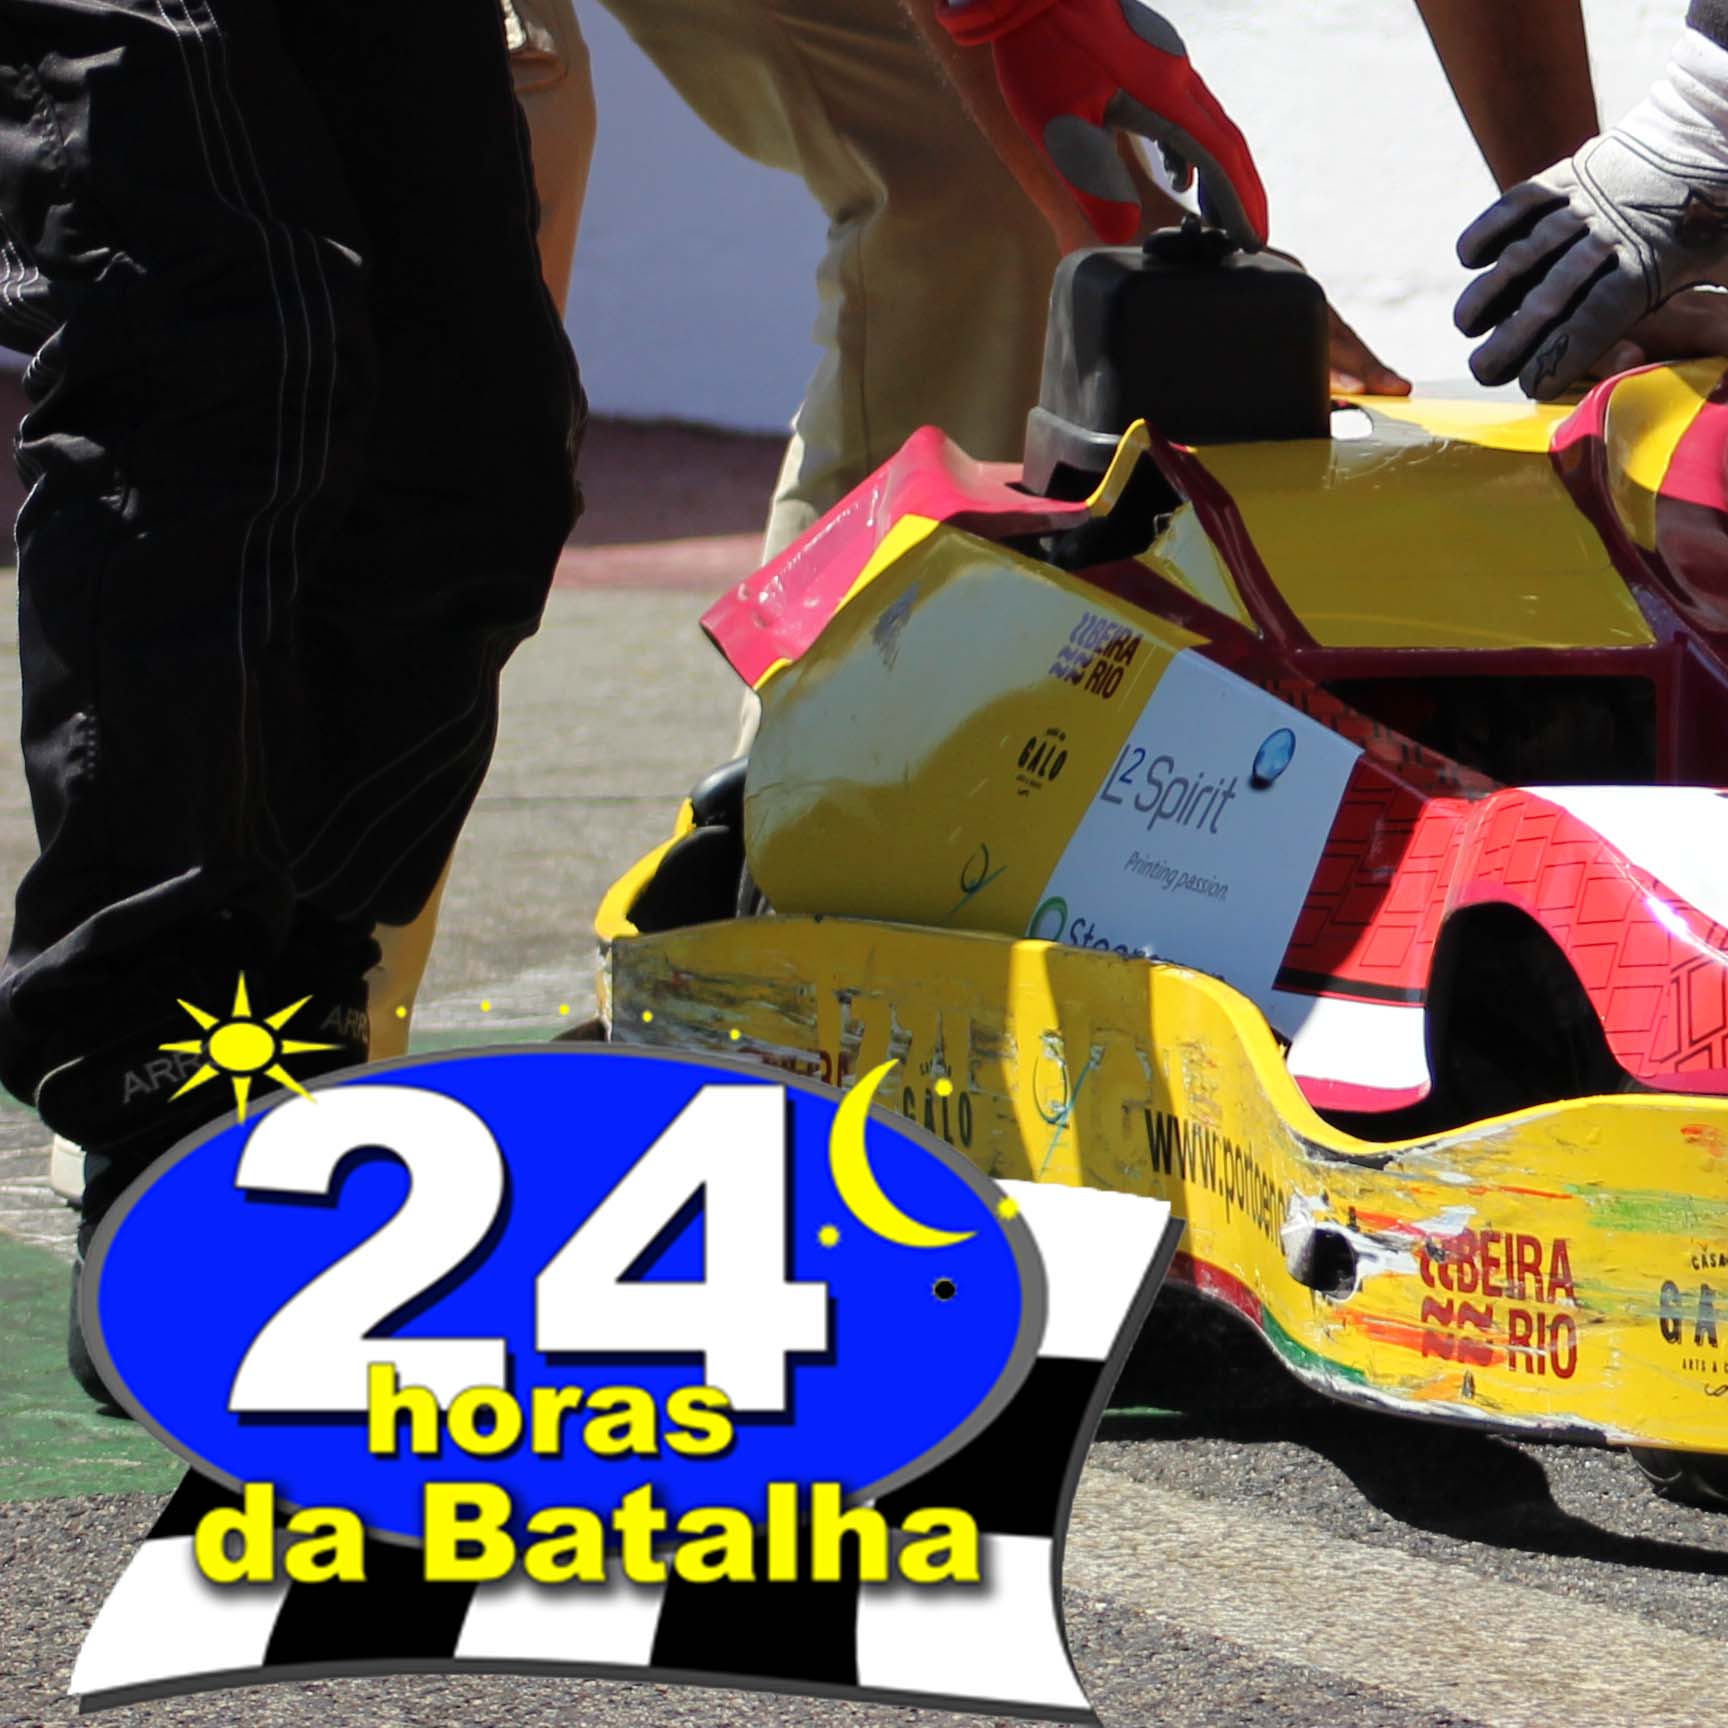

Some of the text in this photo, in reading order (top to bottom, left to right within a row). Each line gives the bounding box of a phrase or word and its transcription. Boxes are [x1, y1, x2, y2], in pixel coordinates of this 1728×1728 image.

[1084, 660, 1125, 700] RIO
[1017, 734, 1069, 782] GALO
[1123, 850, 1179, 892] Printing
[1507, 1307, 1578, 1380] RIO
[1682, 1358, 1706, 1373] ARTS
